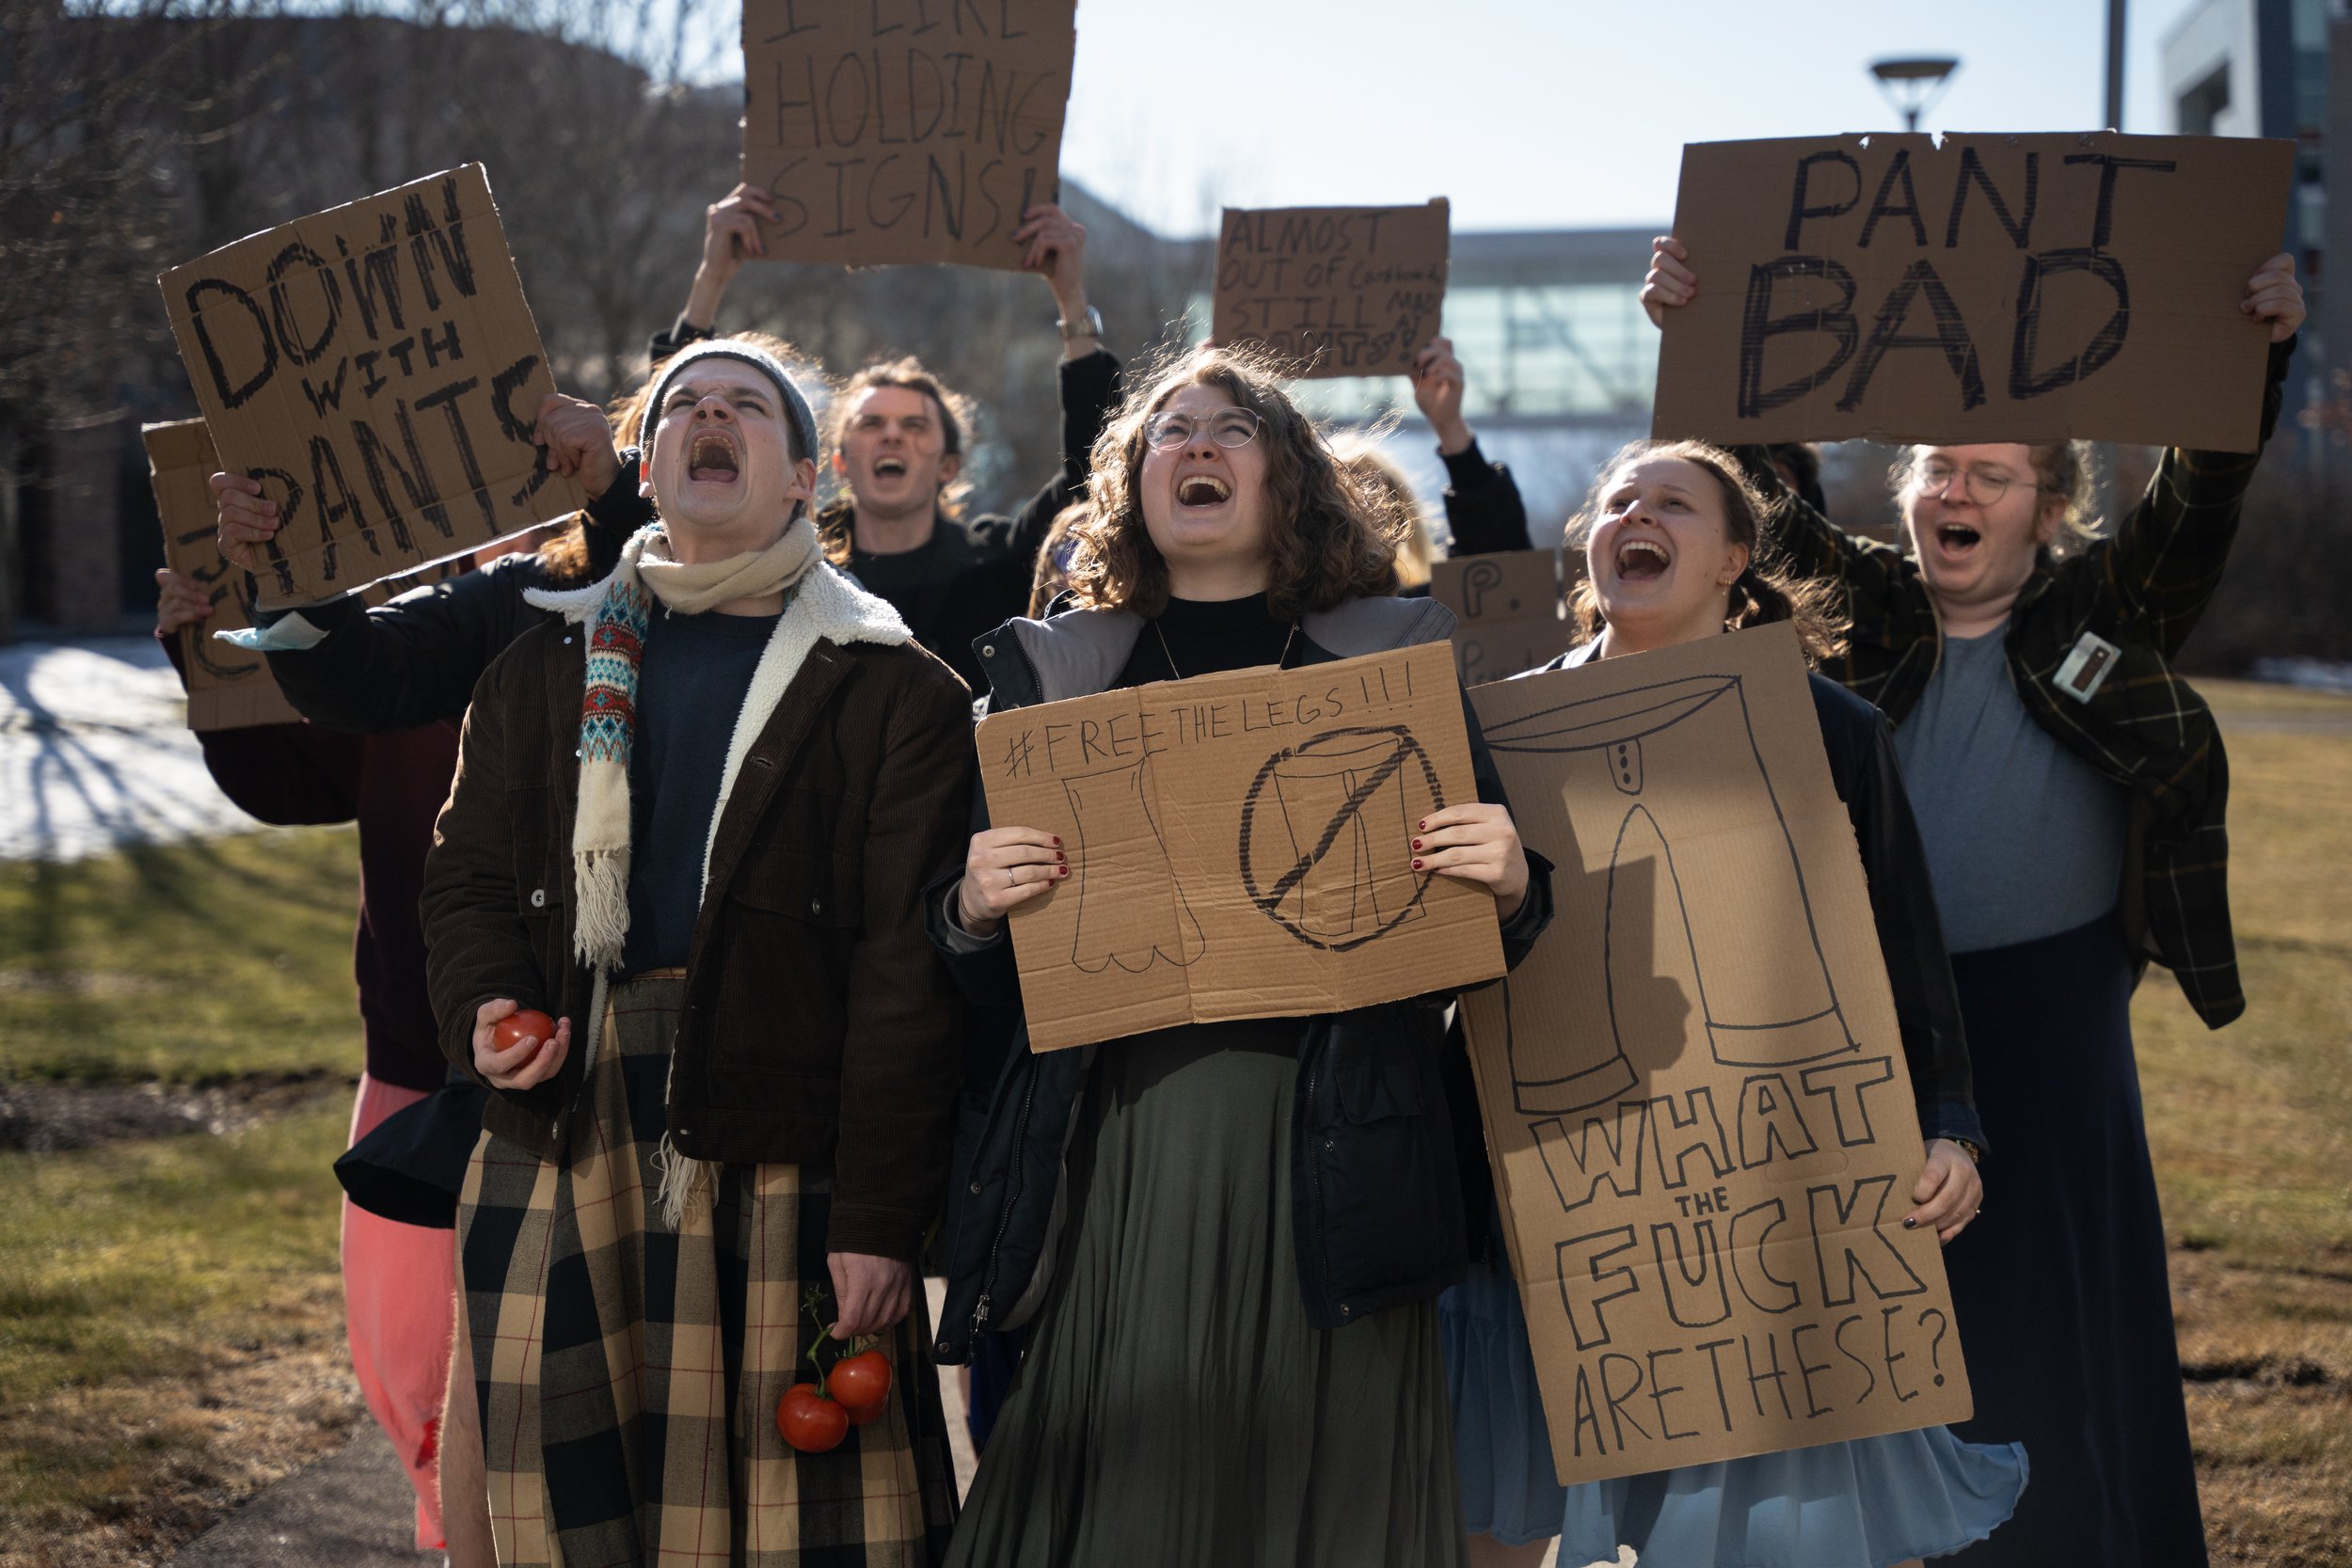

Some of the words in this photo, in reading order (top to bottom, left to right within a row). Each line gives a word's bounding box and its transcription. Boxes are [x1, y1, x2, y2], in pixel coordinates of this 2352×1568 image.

[777, 47, 1057, 155] HOLDING
[1225, 210, 1393, 256] ALMOST
[1785, 147, 2176, 251] PANT
[186, 176, 477, 409] DOWN
[1218, 257, 1292, 293] OUT
[1303, 255, 1346, 289] OF
[1230, 294, 1376, 333] STILL
[303, 321, 463, 420] WITH
[1738, 247, 2129, 419] BAD
[246, 355, 549, 595] PANTS
[1528, 1055, 1894, 1212] WHAT
[1675, 1186, 1729, 1217] THE
[1554, 1174, 1928, 1352] FUCK
